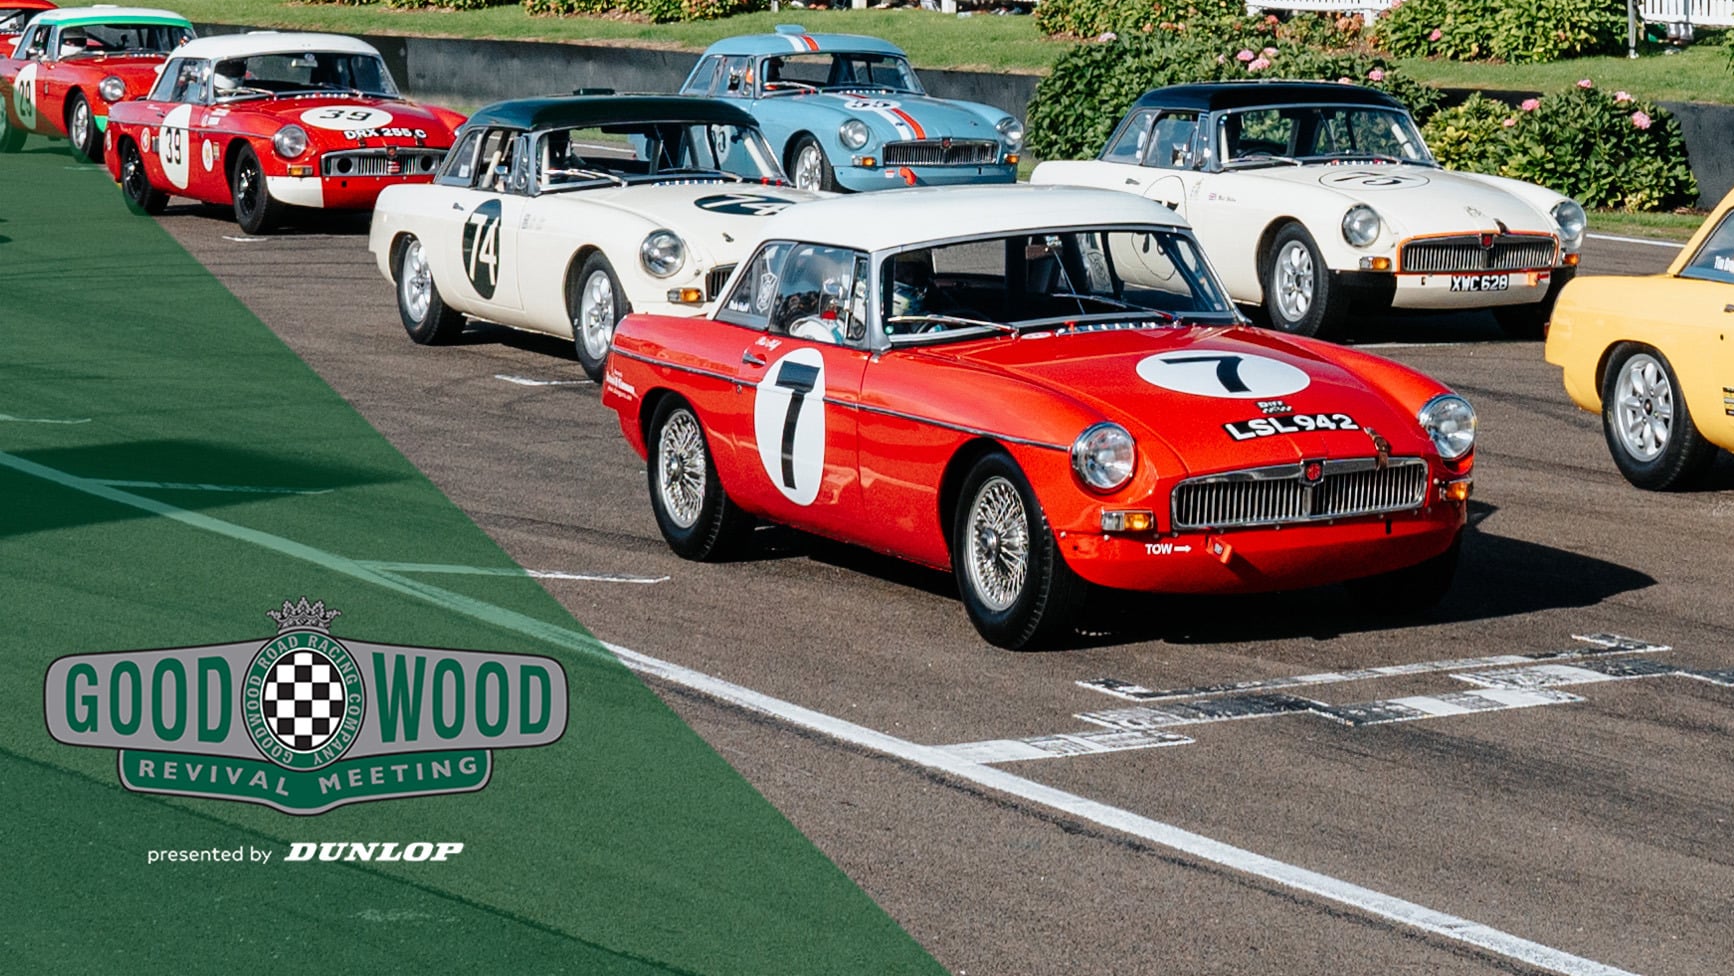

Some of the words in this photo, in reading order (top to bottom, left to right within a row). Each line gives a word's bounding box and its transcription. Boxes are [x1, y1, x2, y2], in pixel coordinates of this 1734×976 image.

[19, 80, 32, 117] 29
[317, 109, 372, 121] 39
[166, 127, 182, 165] 39
[702, 194, 794, 216] 74
[469, 213, 500, 286] 74
[1160, 356, 1251, 393] 7
[775, 361, 821, 490] 7
[1145, 543, 1173, 555] TOW
